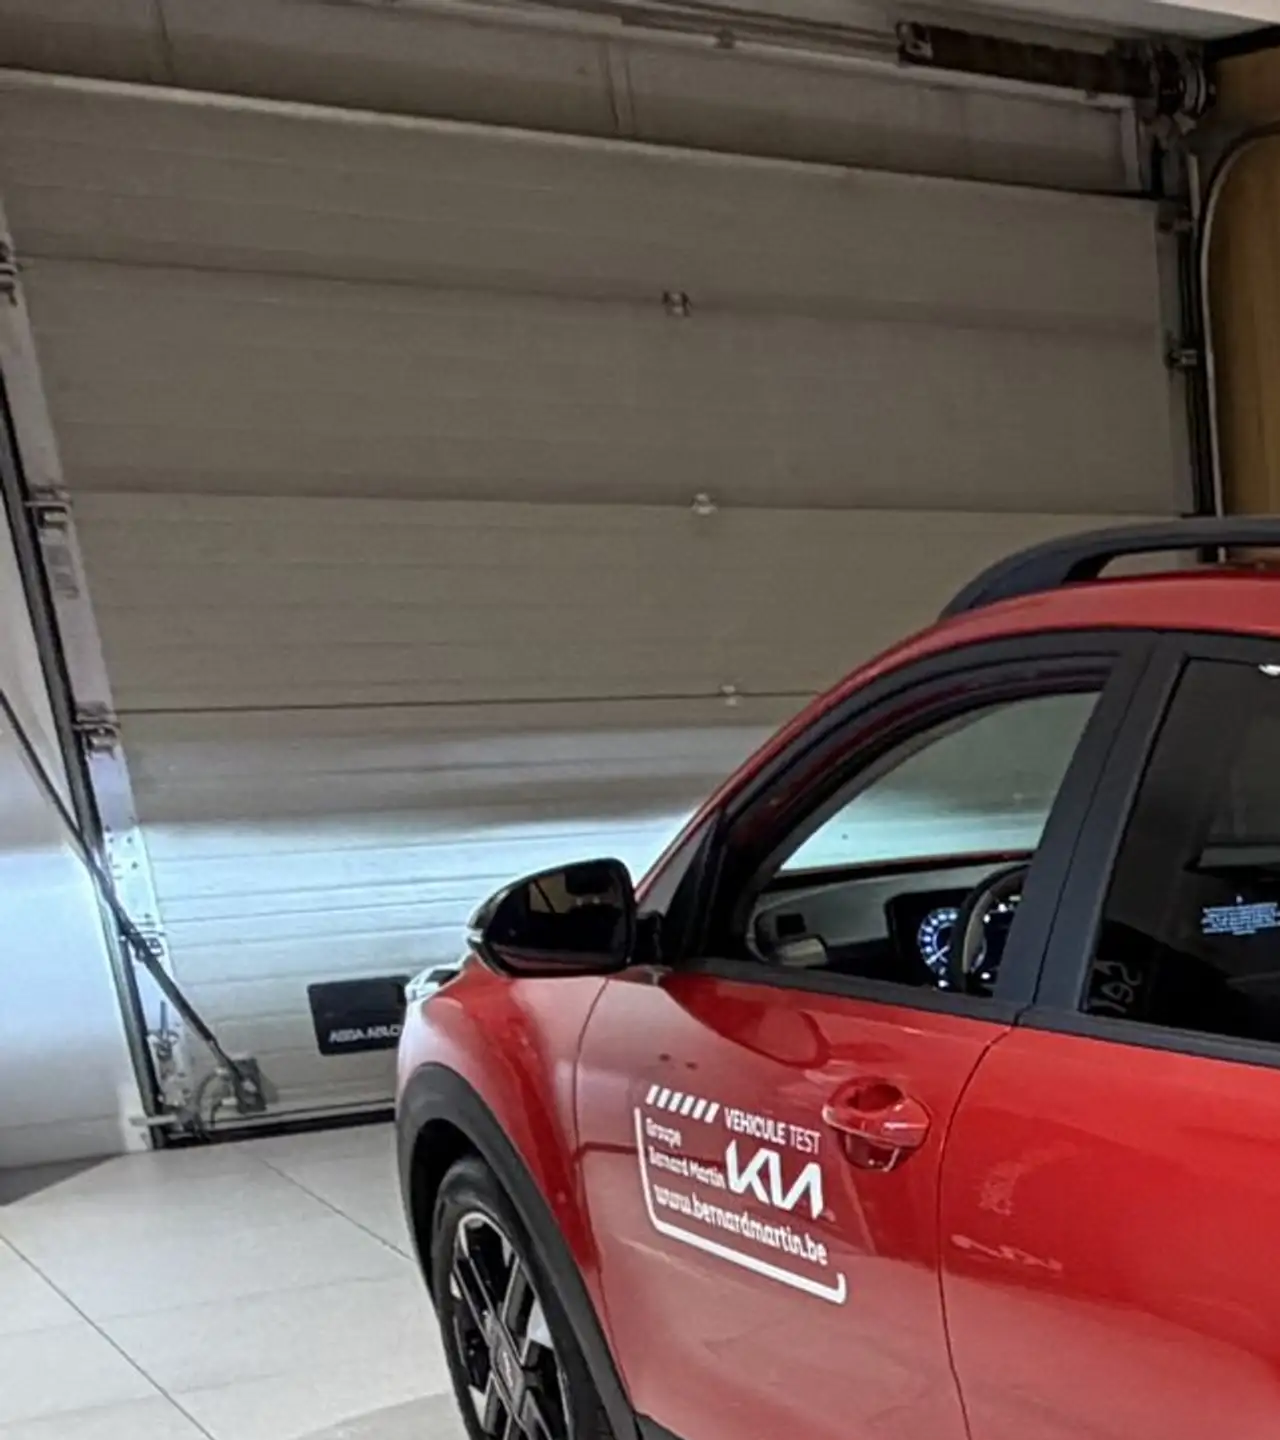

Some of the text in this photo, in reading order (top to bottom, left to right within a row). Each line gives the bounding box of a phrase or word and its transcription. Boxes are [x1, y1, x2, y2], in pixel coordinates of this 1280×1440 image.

[648, 1145, 727, 1190] Bernard Martin
[788, 1125, 822, 1154] TEST
[725, 1139, 824, 1220] KIA
[653, 1183, 829, 1266] www.bernardmartin.be
